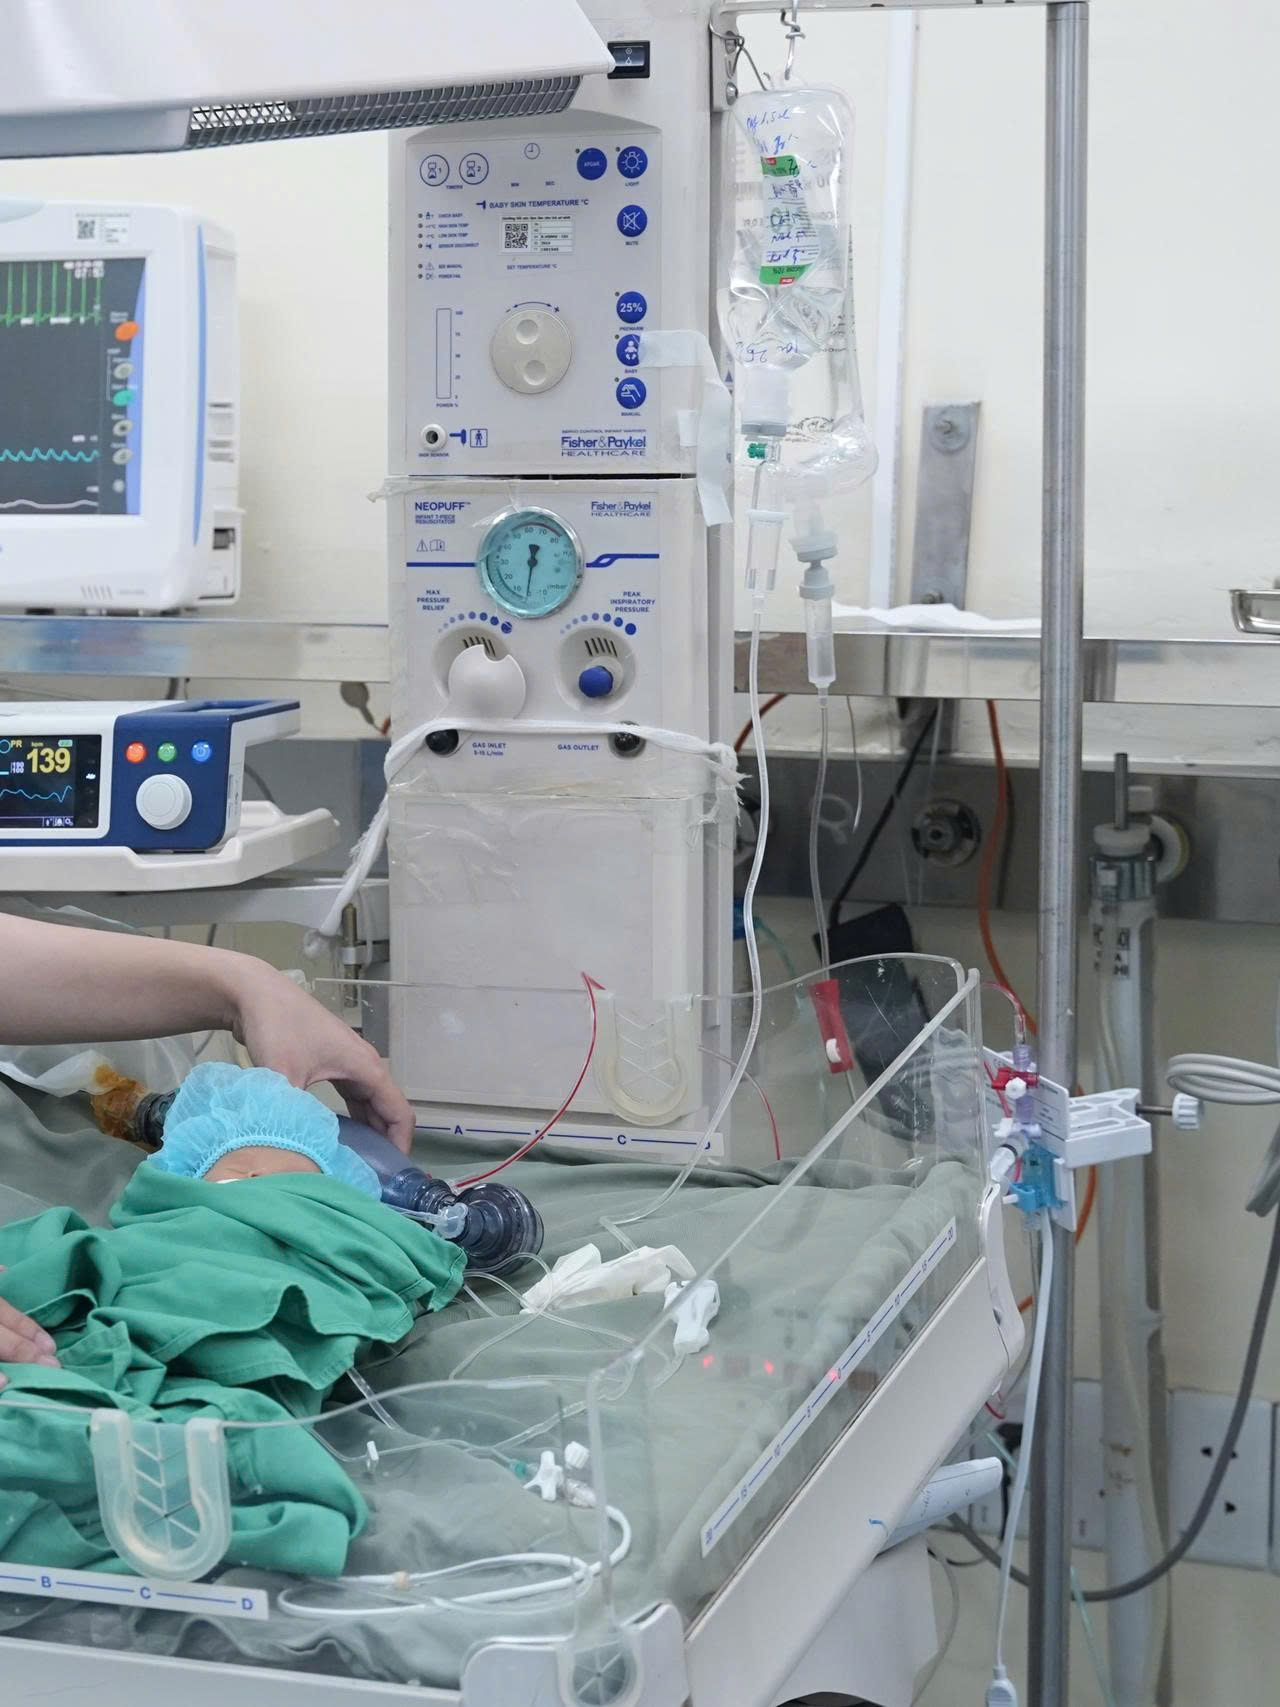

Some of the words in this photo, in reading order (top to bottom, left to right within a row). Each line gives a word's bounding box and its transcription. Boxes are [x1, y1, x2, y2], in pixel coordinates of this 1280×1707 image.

[528, 199, 579, 207] TEMPERATURE
[620, 303, 643, 312] 25%
[11, 740, 22, 748] PR
[27, 748, 71, 773] 139
[453, 1125, 463, 1135] A
[617, 1134, 627, 1145] C
[41, 1576, 52, 1588] B
[140, 1587, 151, 1599] C
[241, 1598, 253, 1610] D
